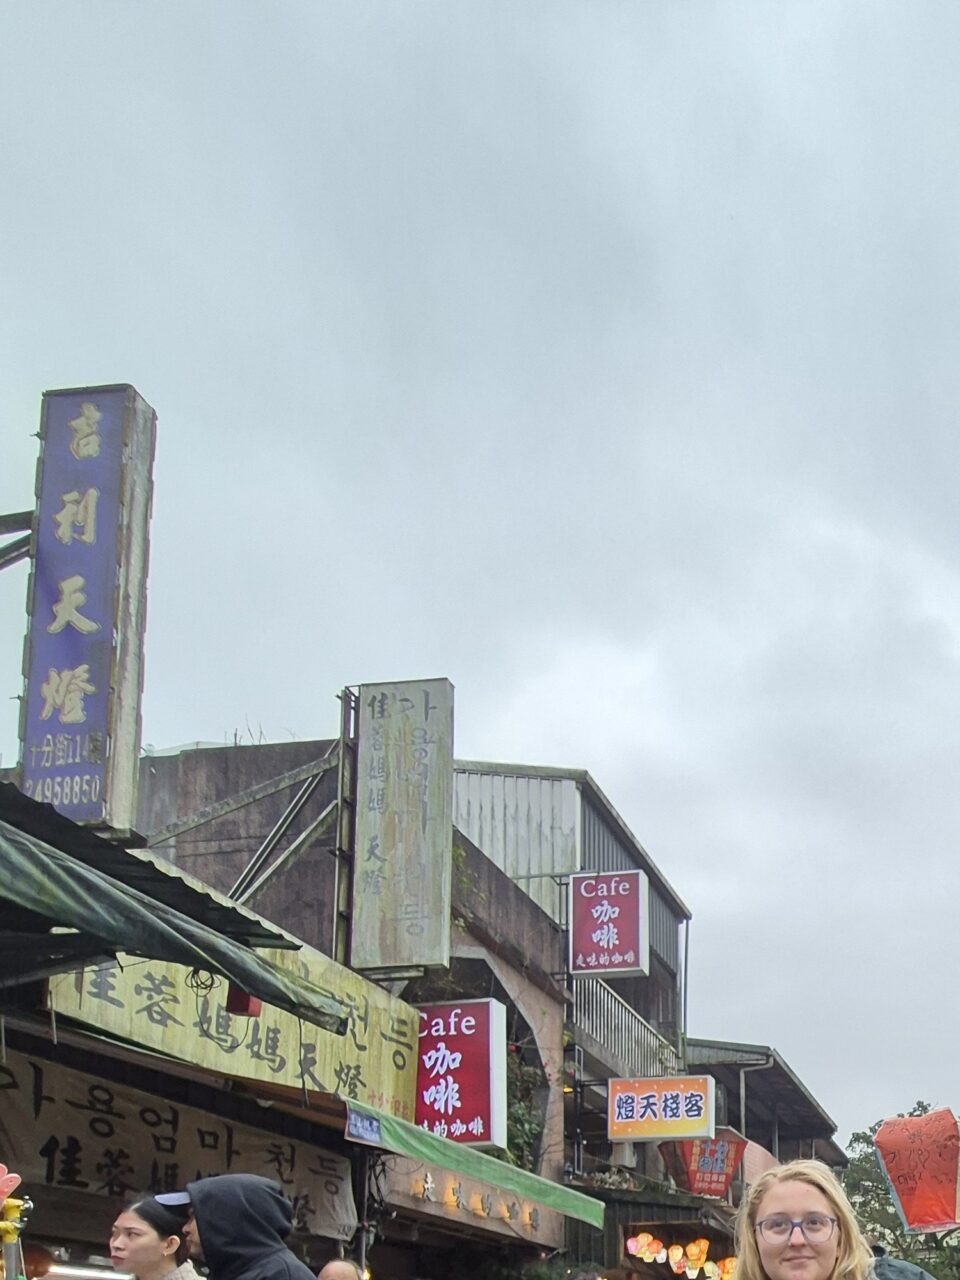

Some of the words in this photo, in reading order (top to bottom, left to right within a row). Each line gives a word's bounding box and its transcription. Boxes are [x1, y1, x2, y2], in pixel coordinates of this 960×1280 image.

[580, 877, 631, 898] Cafe
[591, 899, 620, 950] 咖啡
[418, 1008, 476, 1038] Cafe
[422, 1042, 462, 1116] 咖啡
